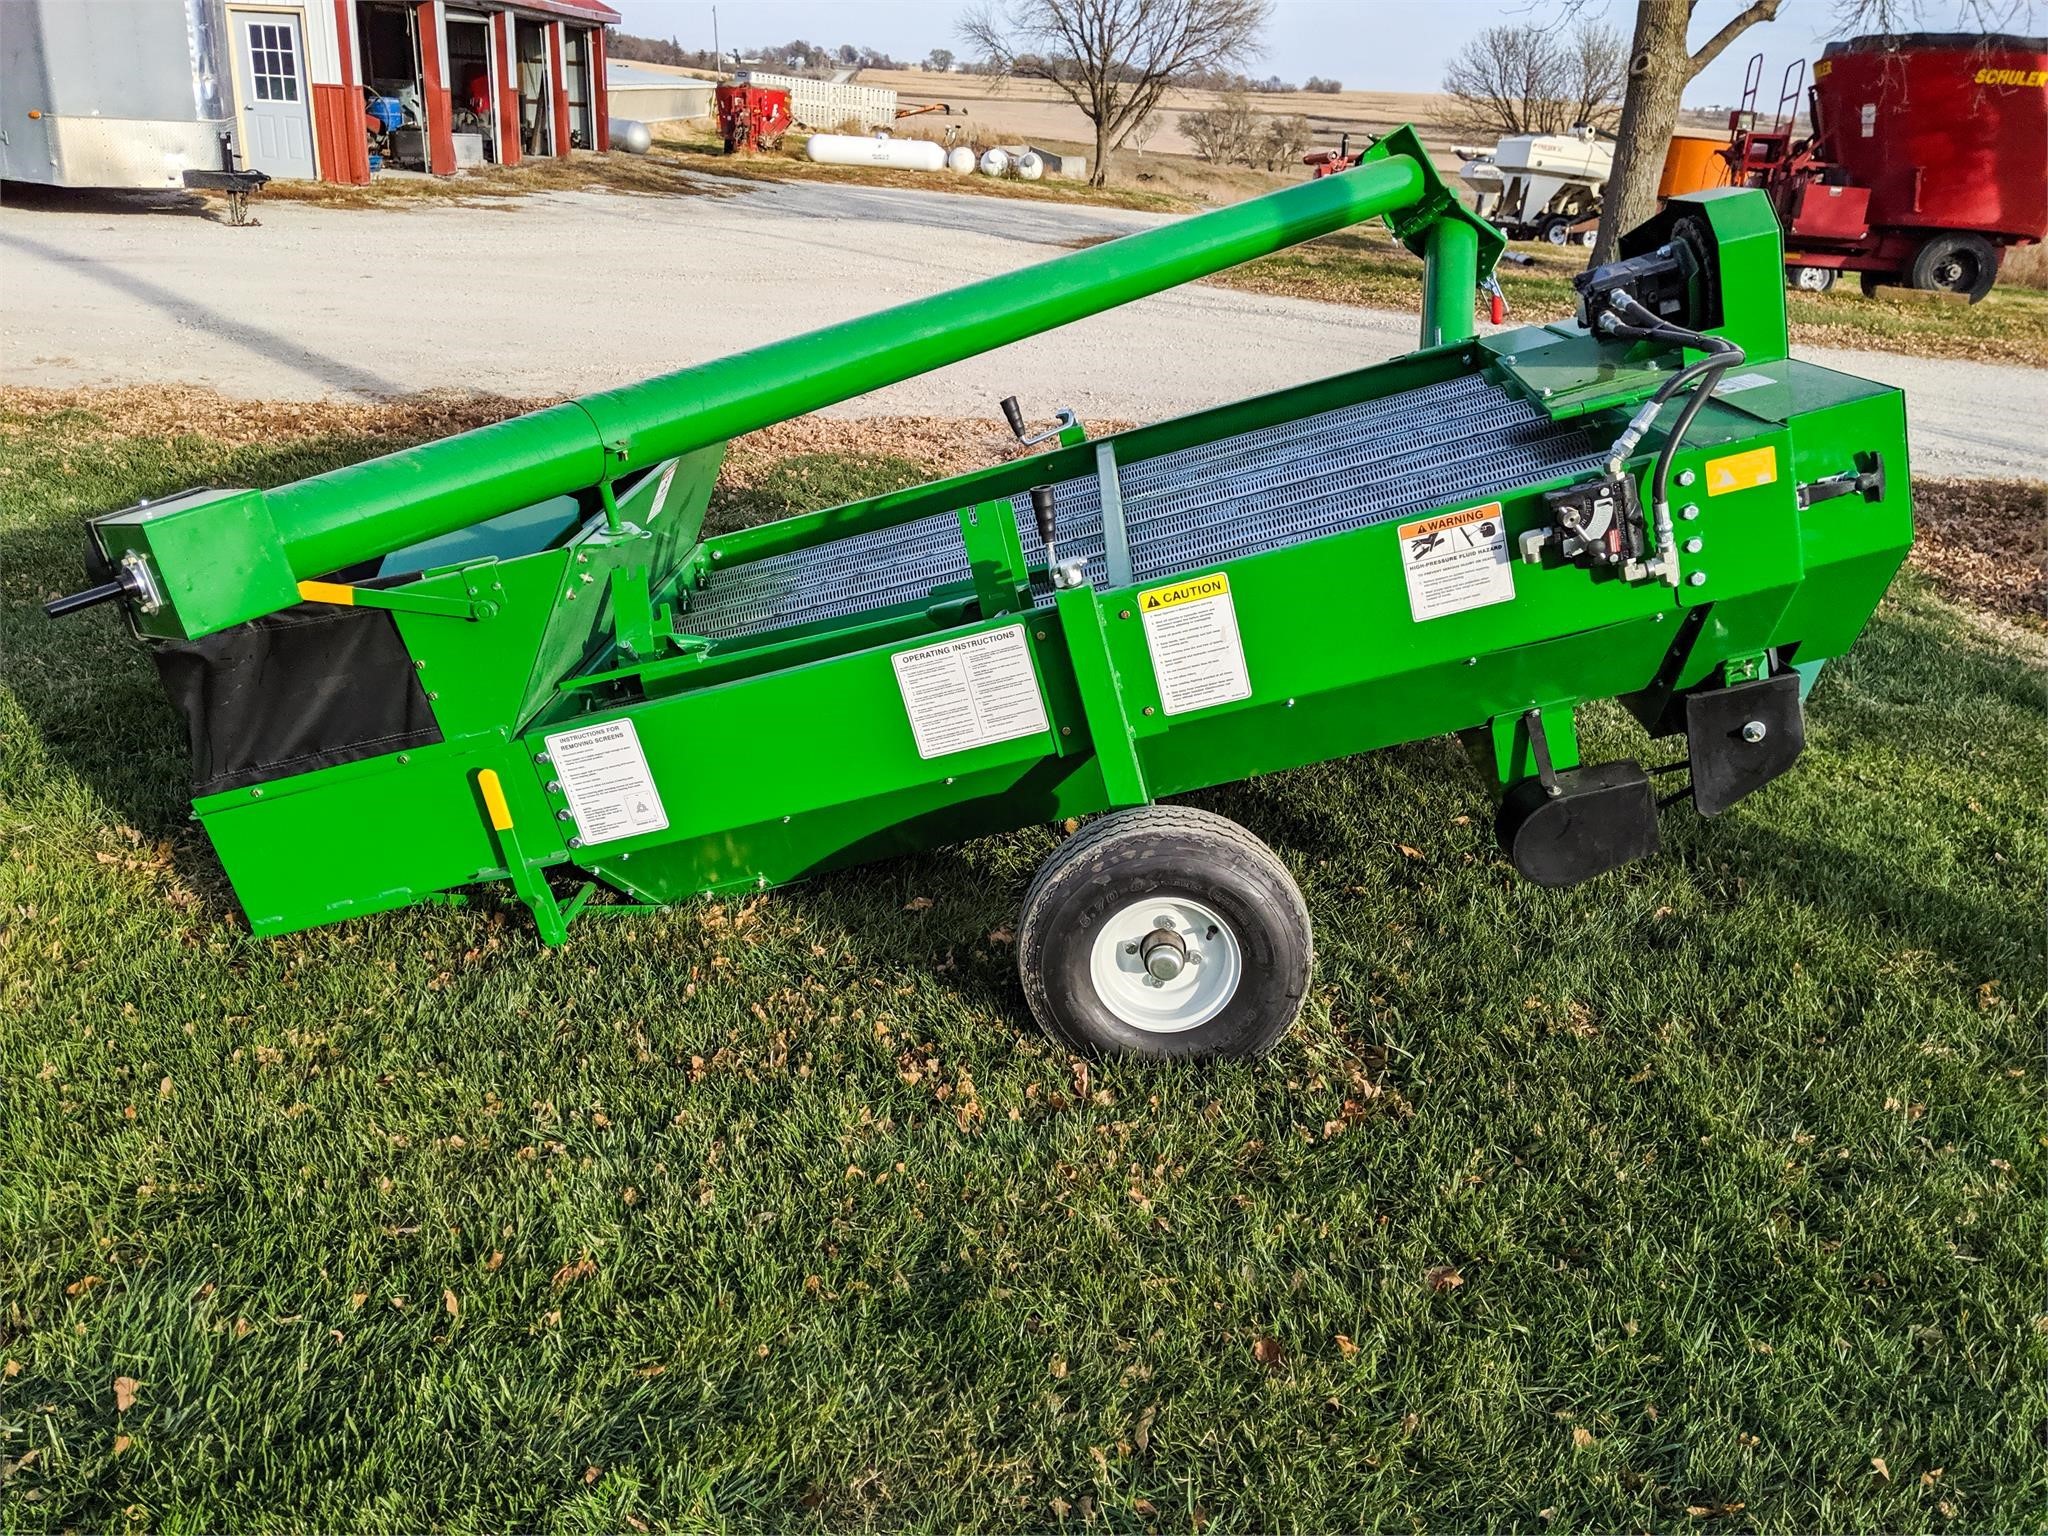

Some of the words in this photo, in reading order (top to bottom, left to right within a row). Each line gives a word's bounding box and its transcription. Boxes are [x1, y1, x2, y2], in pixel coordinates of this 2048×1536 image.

[1427, 510, 1484, 531] WARNING
[1409, 553, 1458, 571] HIGH-PRESSURE
[1458, 550, 1477, 560] FLUID
[1477, 544, 1503, 555] HAZARD
[1162, 580, 1222, 603] CAUTION
[902, 646, 951, 664] OPERATING
[951, 630, 1015, 653] INSTRUCTIONS
[559, 728, 606, 743] INSTRUCTIONS
[606, 725, 620, 734] FOR
[560, 739, 594, 751] REMOVING
[594, 732, 624, 744] SCREENS
